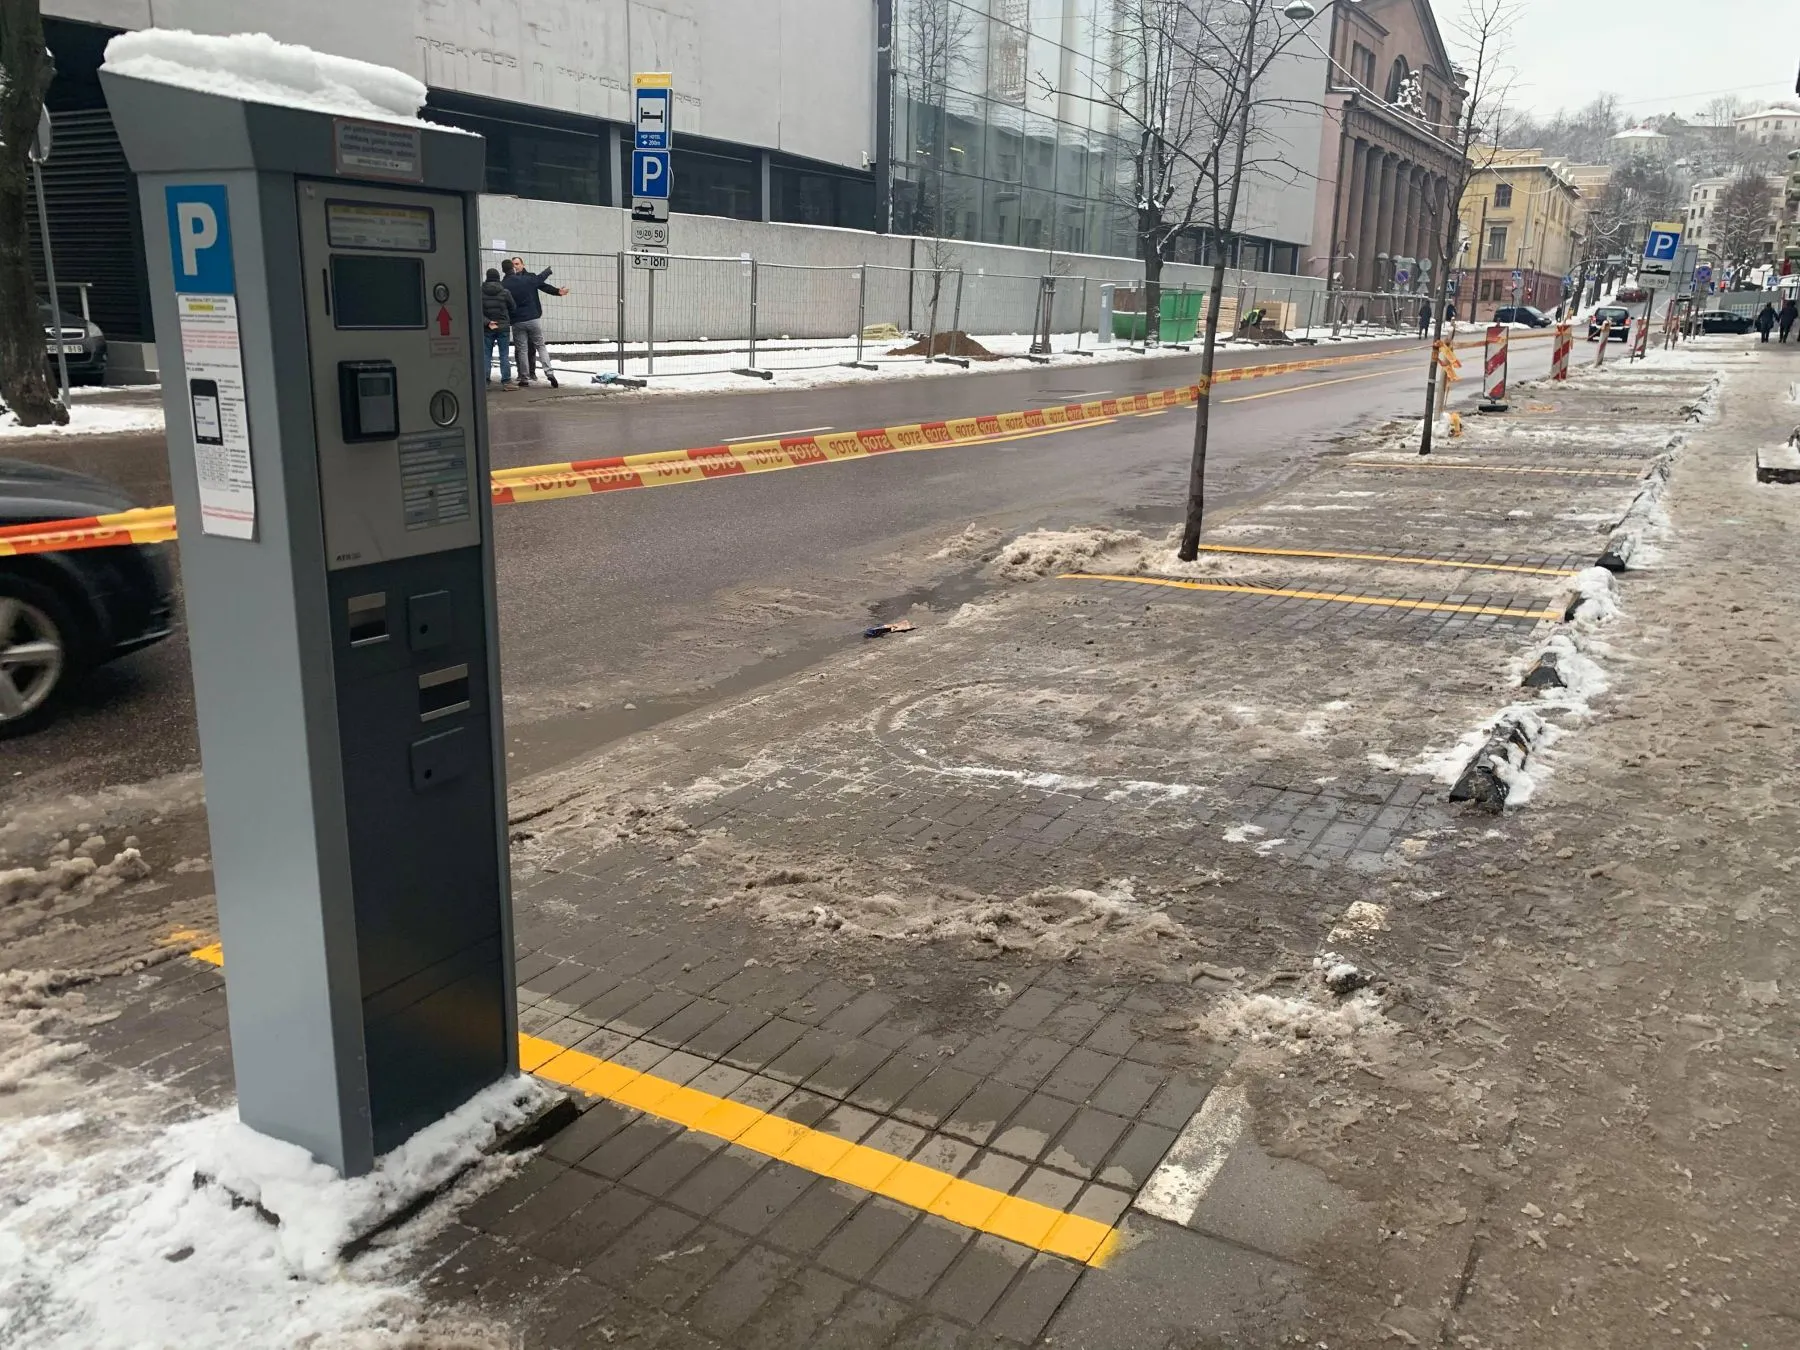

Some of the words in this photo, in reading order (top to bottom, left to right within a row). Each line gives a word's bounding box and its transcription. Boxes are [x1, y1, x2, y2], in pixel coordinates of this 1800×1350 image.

[643, 156, 662, 192] P
[176, 202, 218, 276] P
[655, 229, 663, 239] 50
[1653, 234, 1673, 256] P
